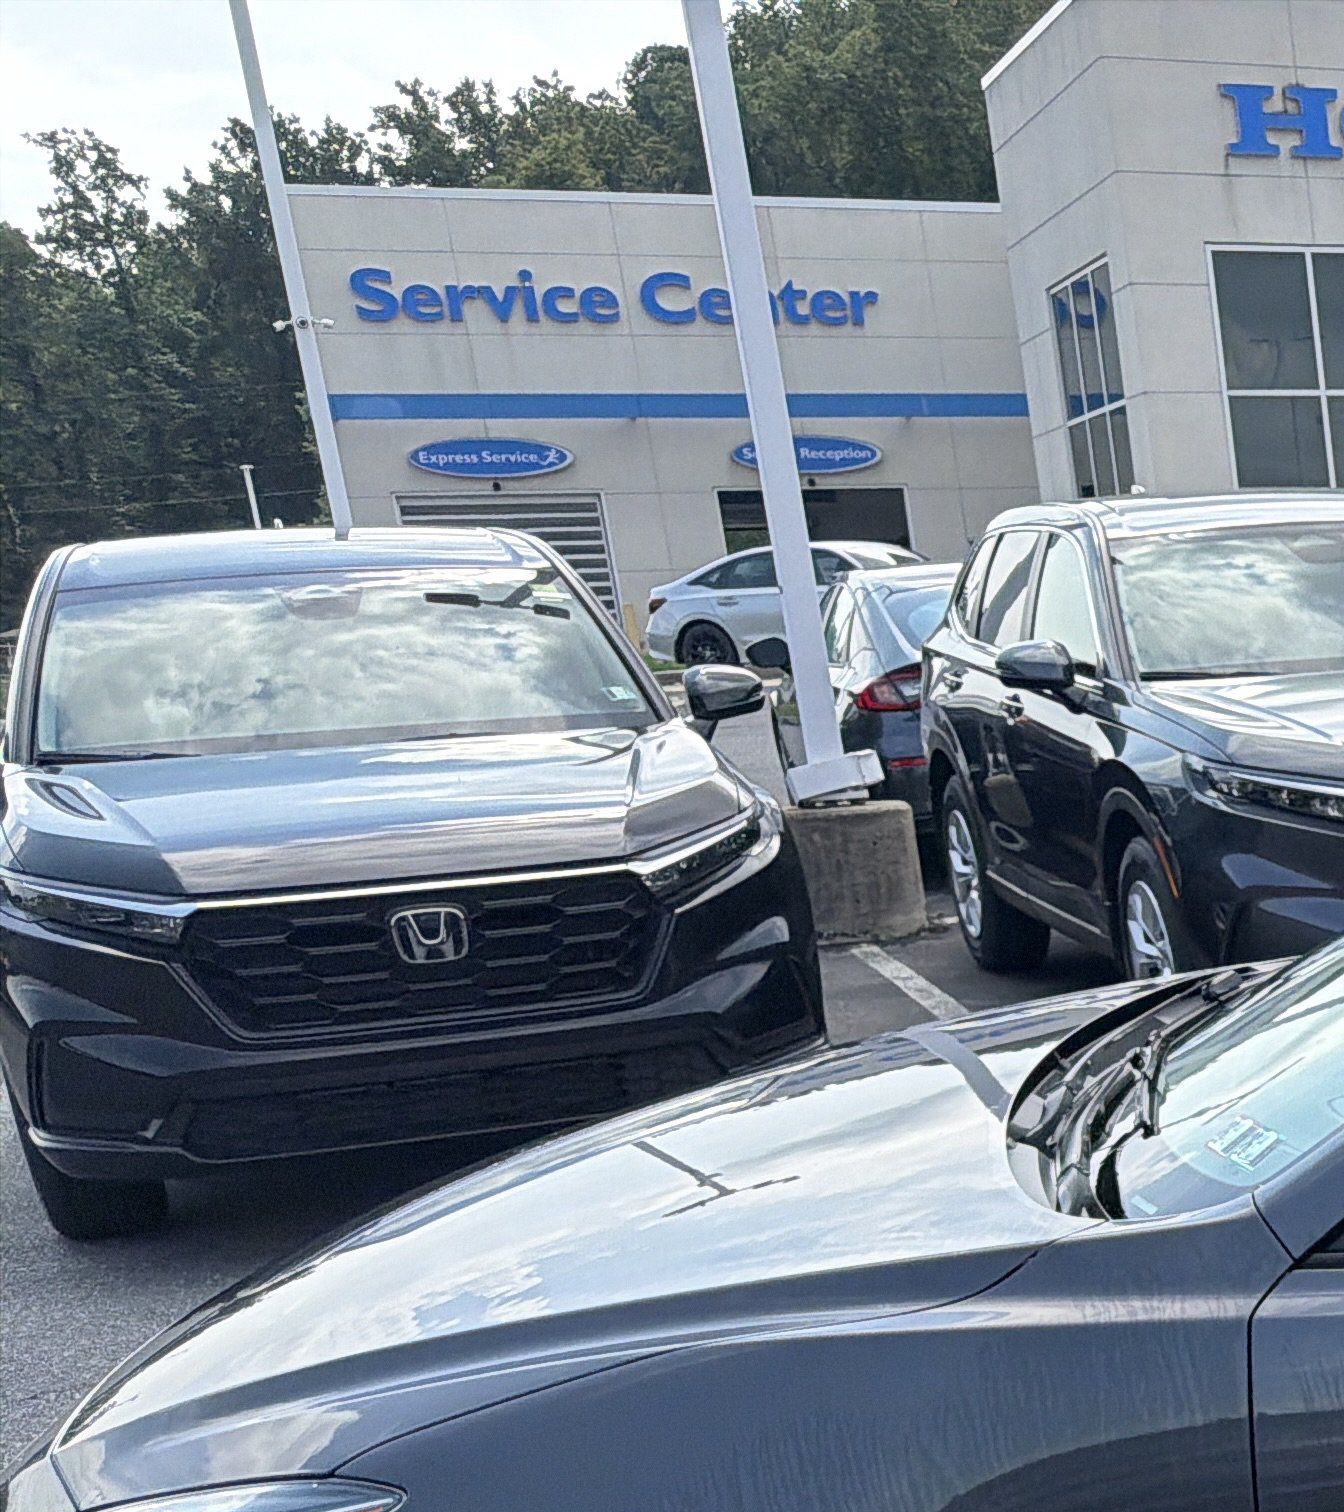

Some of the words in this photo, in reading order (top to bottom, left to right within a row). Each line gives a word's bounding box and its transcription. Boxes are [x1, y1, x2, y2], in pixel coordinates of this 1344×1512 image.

[348, 266, 620, 325] Service
[640, 271, 880, 326] Ceter
[418, 451, 479, 467] Express
[481, 450, 538, 464] Service
[800, 447, 872, 461] Reception
